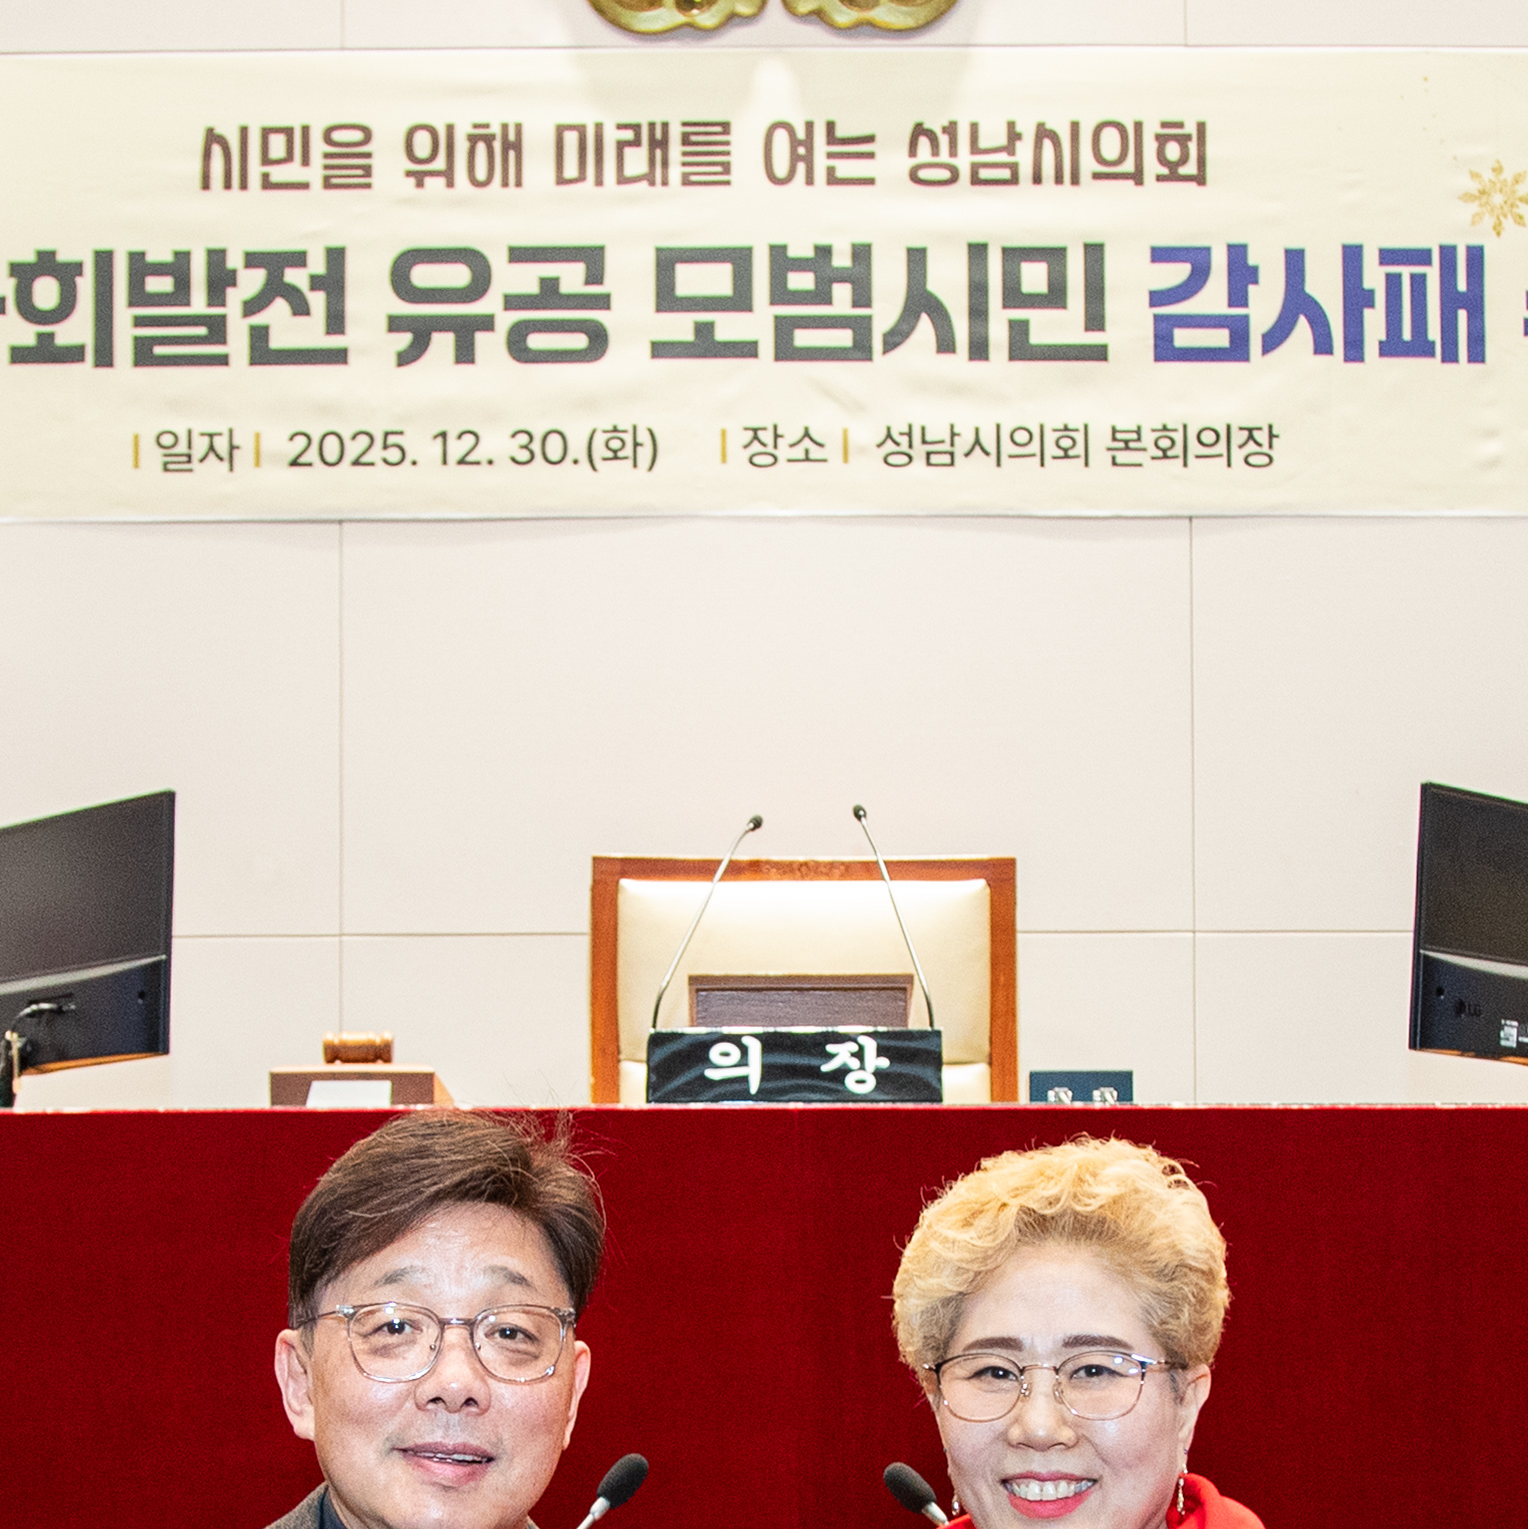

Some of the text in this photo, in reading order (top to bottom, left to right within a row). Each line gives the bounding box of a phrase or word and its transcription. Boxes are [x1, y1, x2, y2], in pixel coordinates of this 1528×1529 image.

[201, 120, 1209, 193] 시민을 위해 미래를 여는 성남시의회
[387, 245, 613, 370] 유공
[650, 242, 1111, 364] 모범시민
[1148, 243, 1488, 366] 감사패
[155, 423, 1281, 474] 일자 2025. 12. 30.(화) 장소 성남시의회 본회의장
[703, 1034, 891, 1096] 의장
